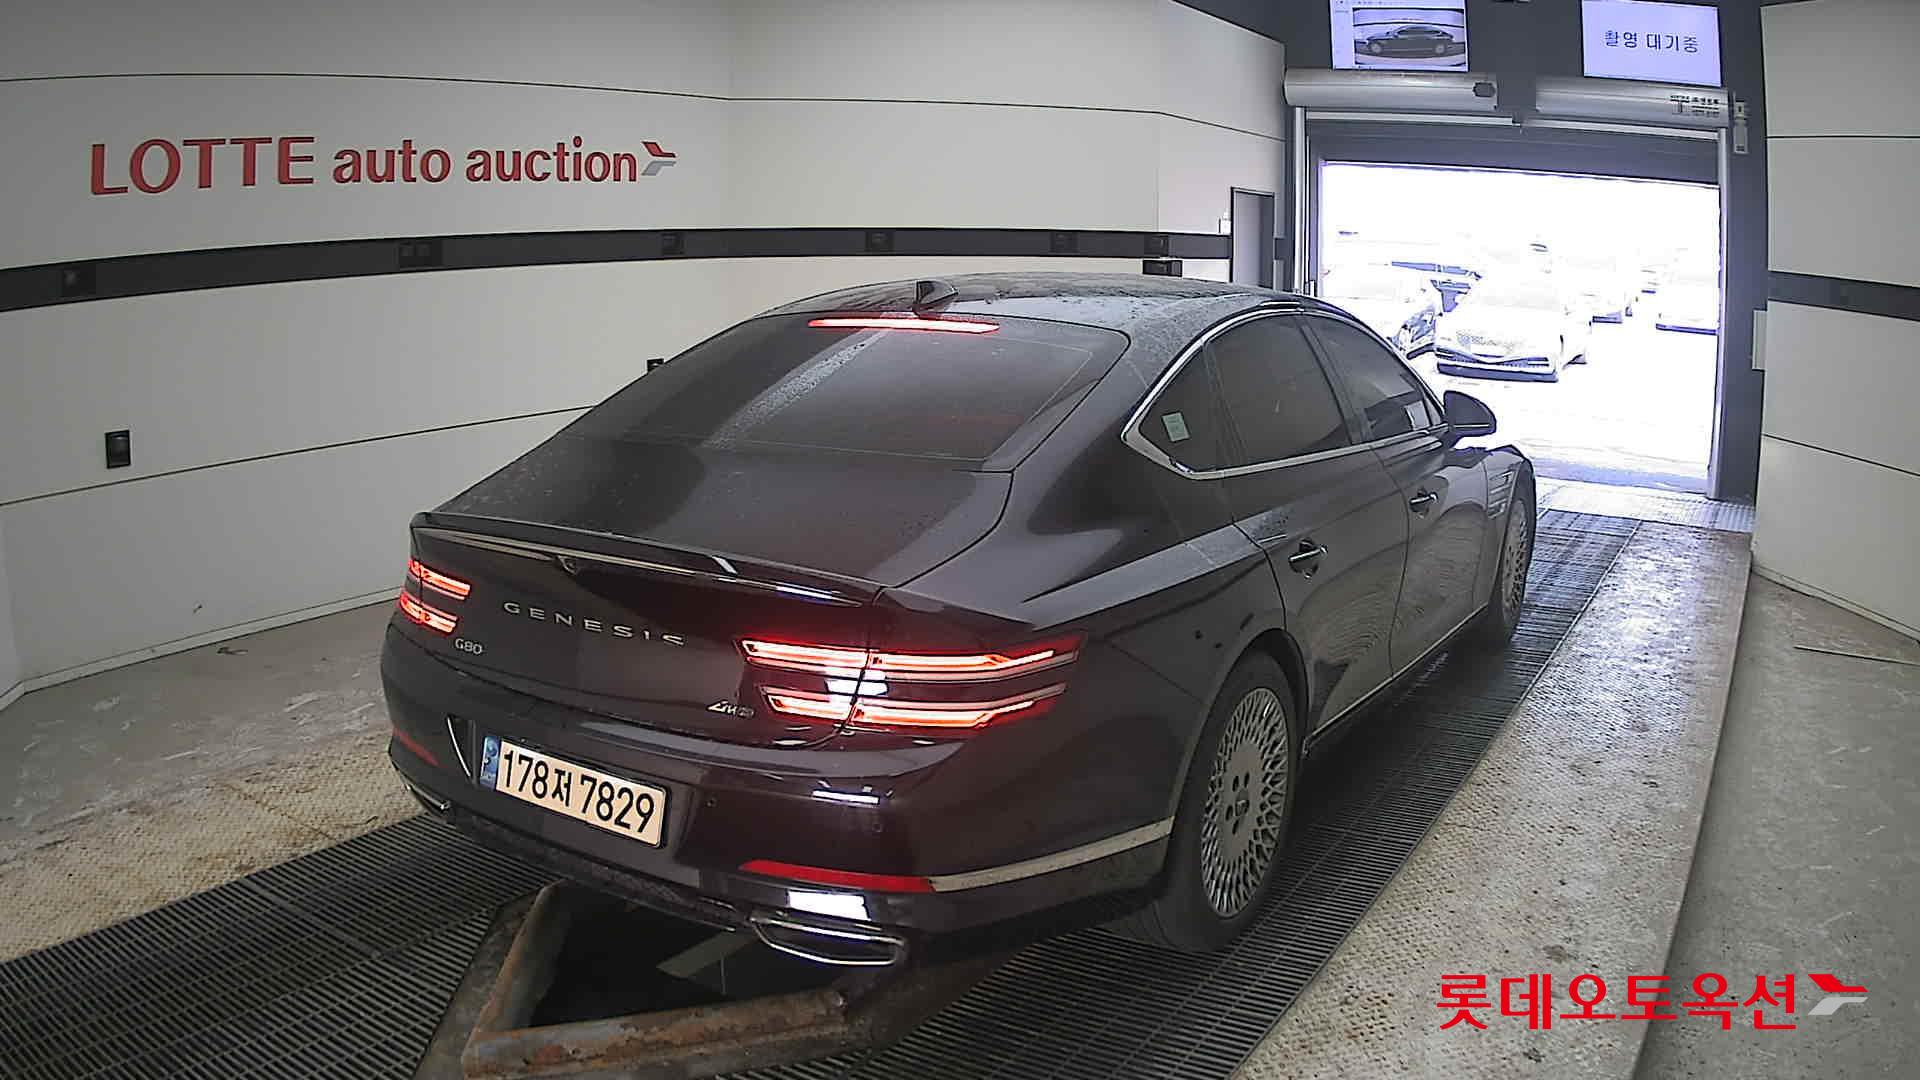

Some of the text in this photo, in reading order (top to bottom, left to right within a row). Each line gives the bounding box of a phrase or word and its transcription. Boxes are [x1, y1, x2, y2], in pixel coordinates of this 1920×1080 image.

[1604, 31, 1698, 53] 촬영 대기중
[90, 135, 638, 195] LOTTE auto auction
[503, 602, 685, 646] GENESIS
[455, 638, 482, 655] G80
[502, 749, 655, 834] 178저 7829
